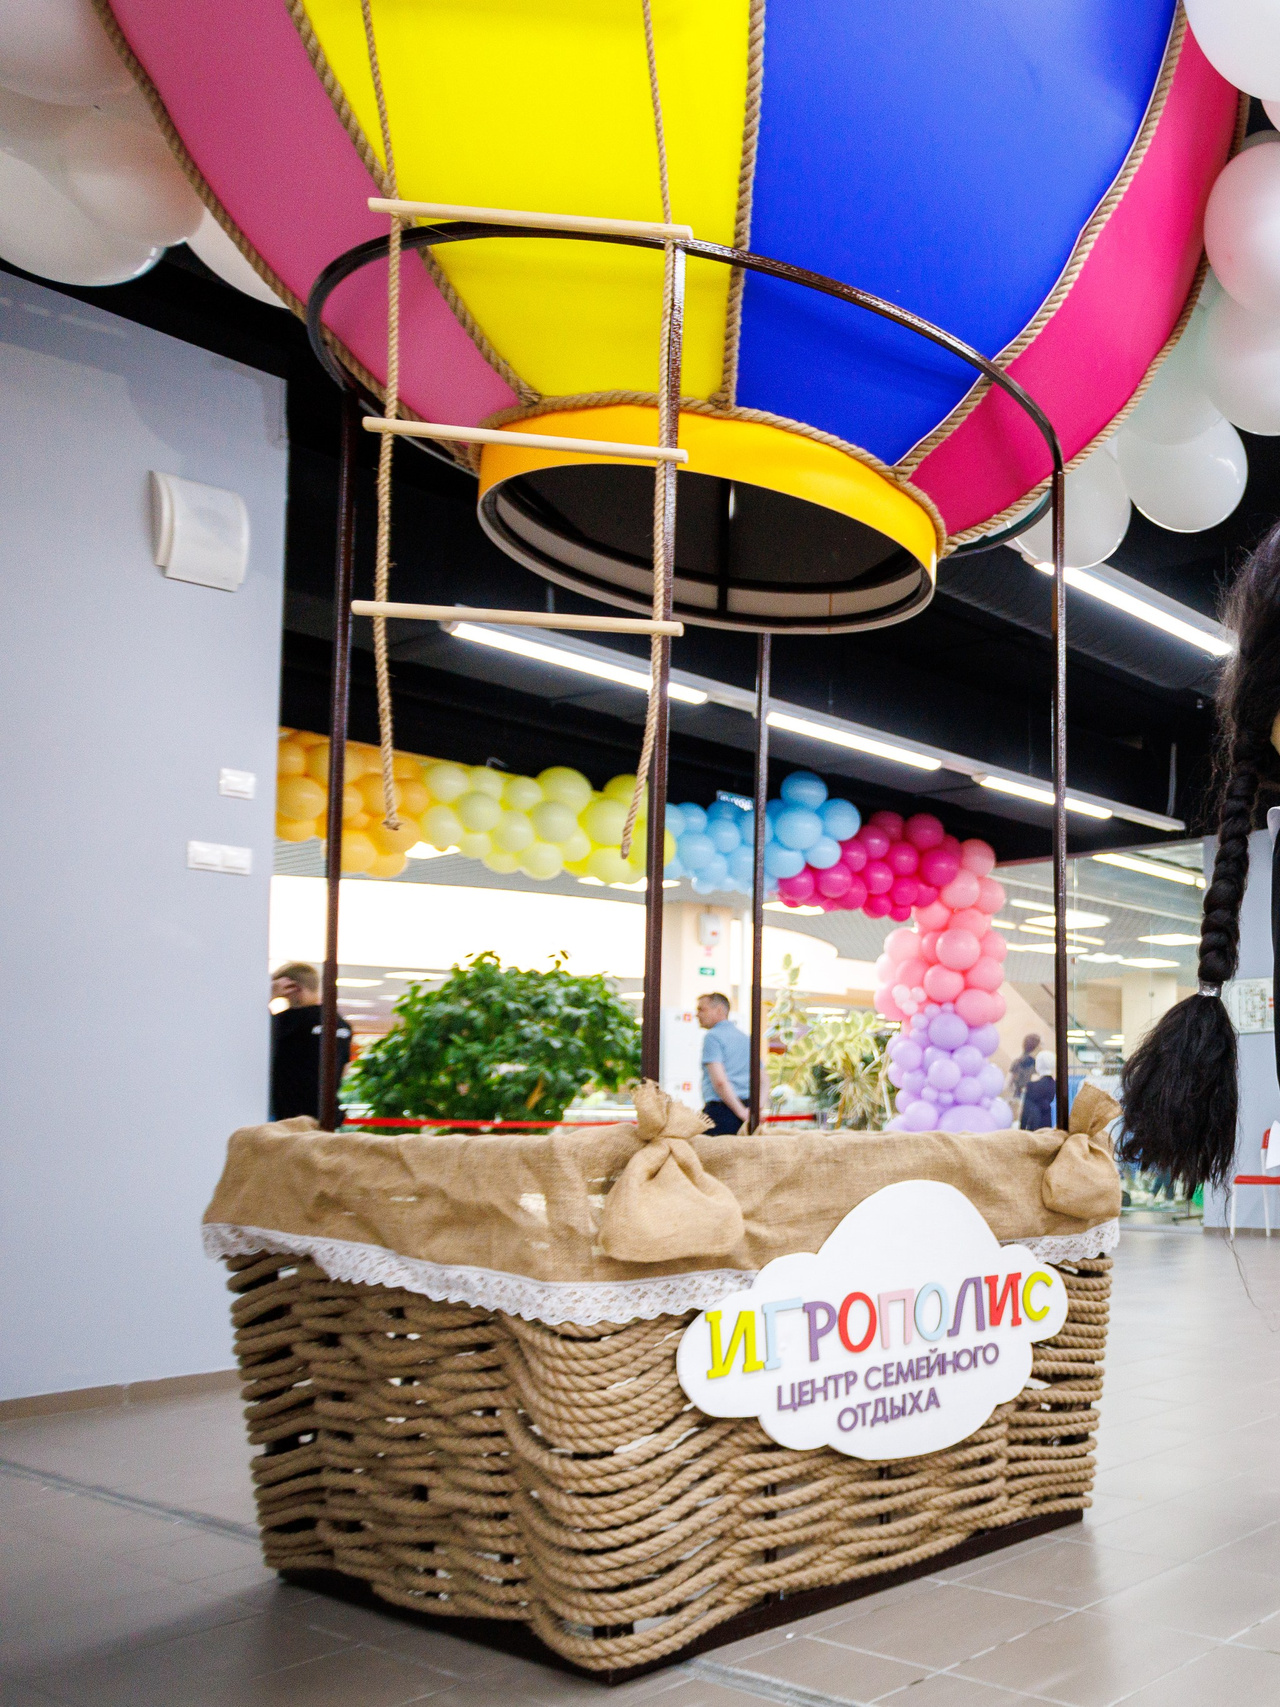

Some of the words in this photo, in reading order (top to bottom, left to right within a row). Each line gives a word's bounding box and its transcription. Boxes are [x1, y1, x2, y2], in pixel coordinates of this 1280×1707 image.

[704, 1271, 1054, 1380] ИГРОПОЛИС
[776, 1370, 859, 1412] ЦЕНТР
[864, 1342, 1000, 1392] СЕМЕЙНОГО
[837, 1386, 941, 1433] ОТДЫХА
